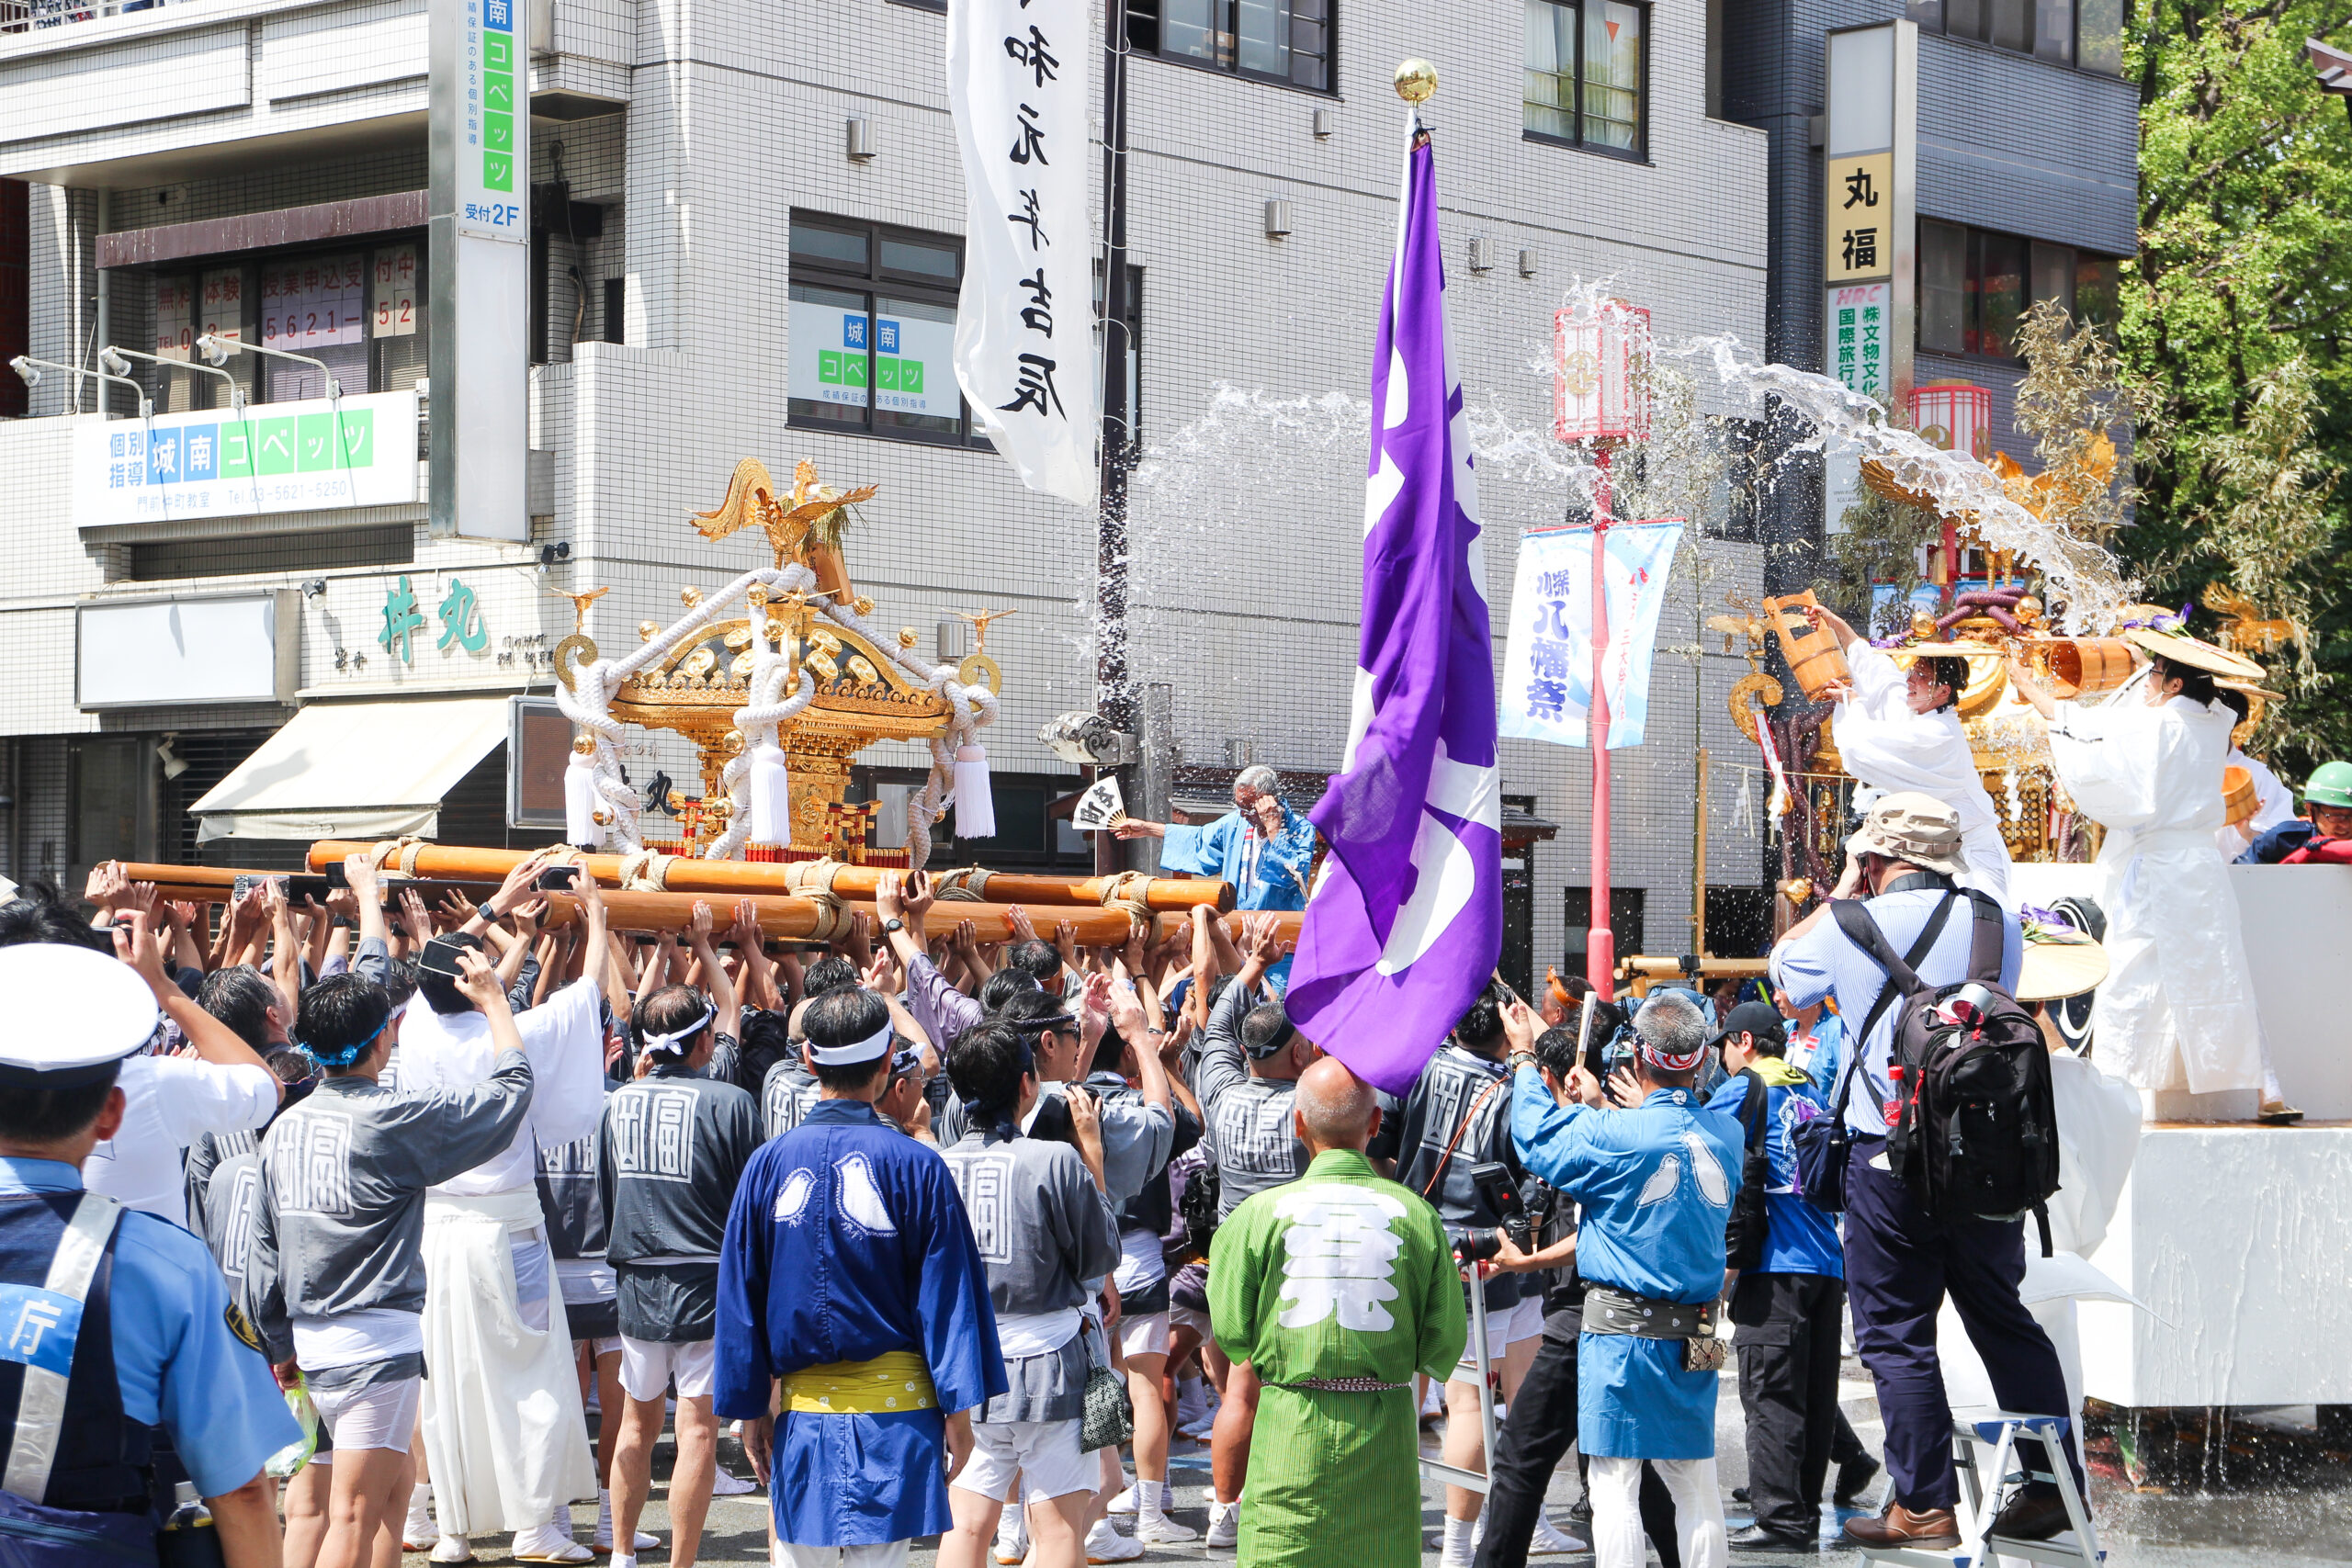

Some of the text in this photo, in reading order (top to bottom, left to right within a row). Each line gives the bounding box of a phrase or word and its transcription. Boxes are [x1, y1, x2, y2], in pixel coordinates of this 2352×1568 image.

[465, 203, 520, 227] 受付2F
[1842, 167, 1879, 270] 丸福
[1836, 285, 1883, 306] HRC
[158, 336, 175, 349] TEL
[847, 321, 896, 348] 城南
[1838, 309, 1856, 392] 国際旅行
[824, 359, 919, 386] コベッツ
[109, 431, 144, 458] 個別
[152, 424, 366, 474] 城南コベッツ
[109, 461, 144, 489] 指導
[137, 491, 210, 513] 門前仲町教室
[228, 480, 347, 505] Tel.03-5621-5250
